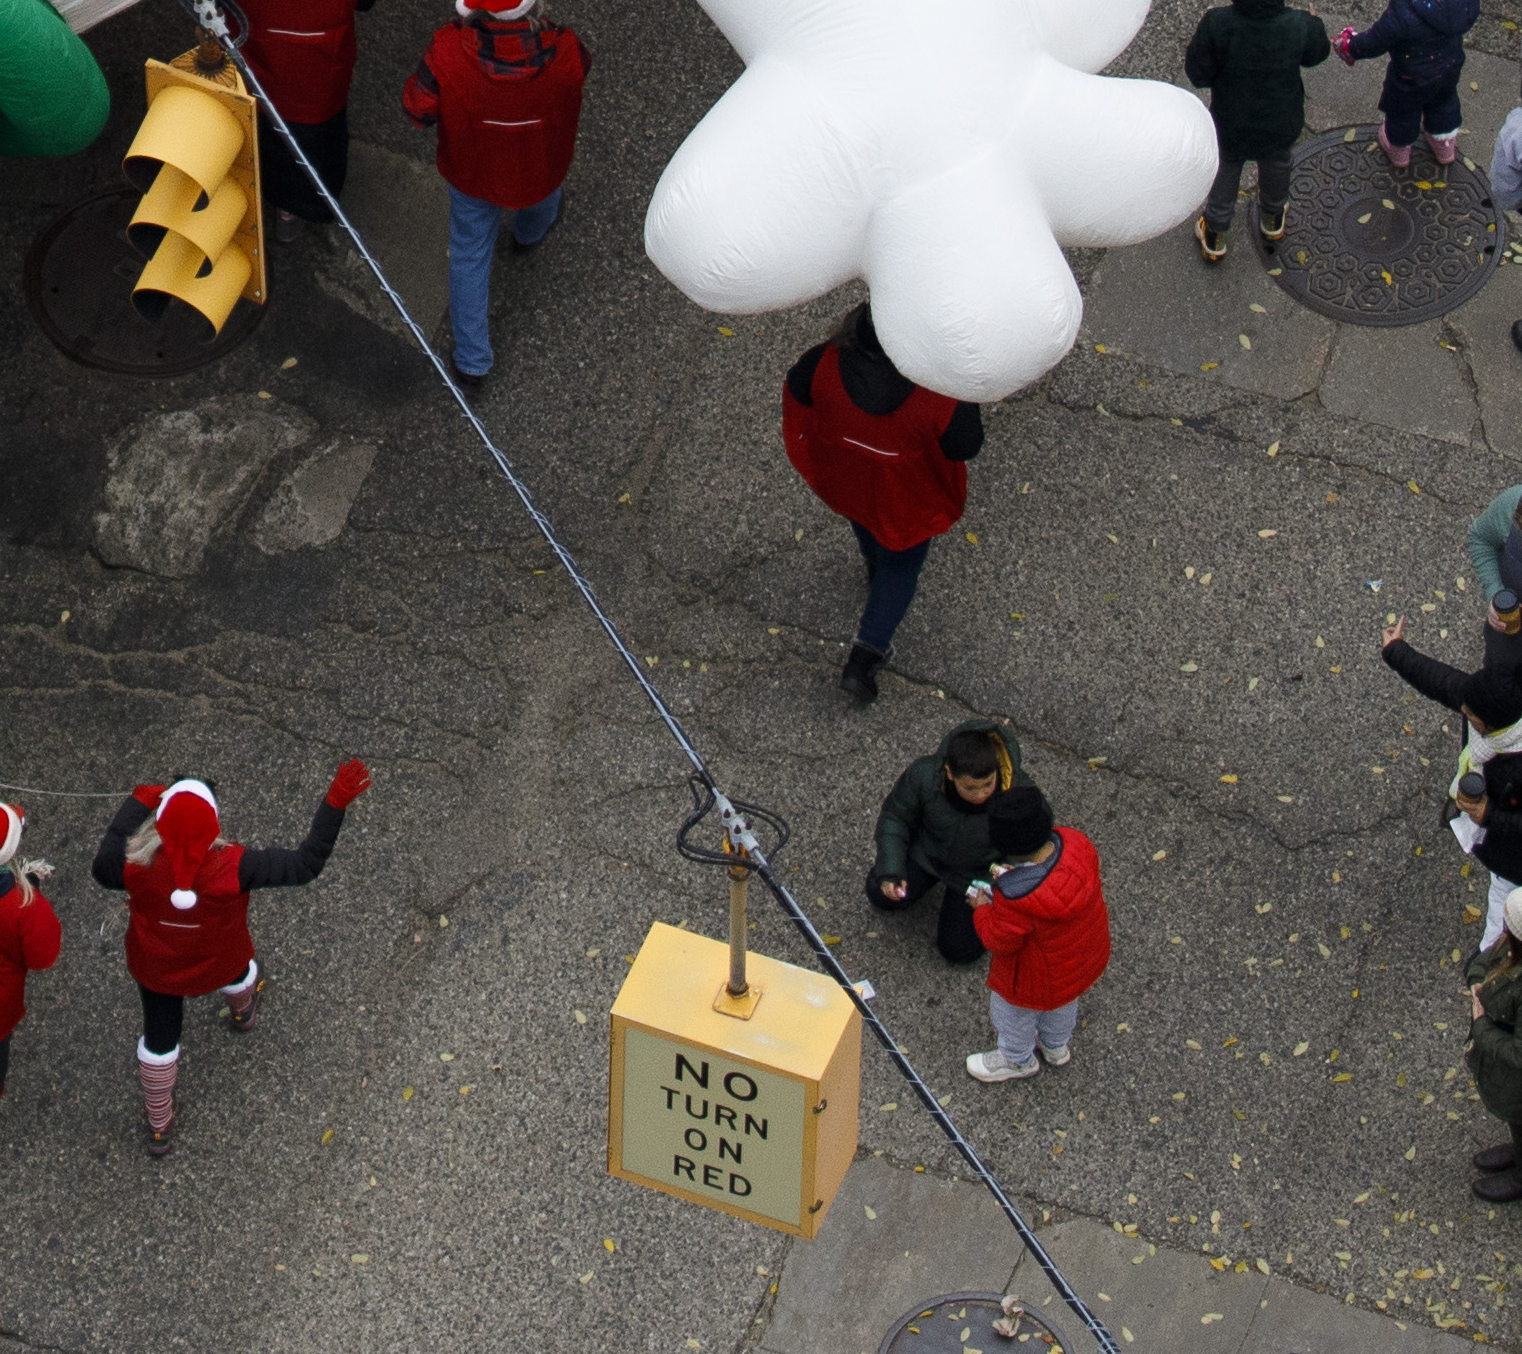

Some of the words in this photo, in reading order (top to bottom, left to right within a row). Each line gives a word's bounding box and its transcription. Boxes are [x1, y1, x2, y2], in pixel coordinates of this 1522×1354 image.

[674, 1053, 759, 1102] NO
[659, 1085, 769, 1141] TURN
[684, 1127, 743, 1165] ON
[673, 1154, 753, 1198] RED
